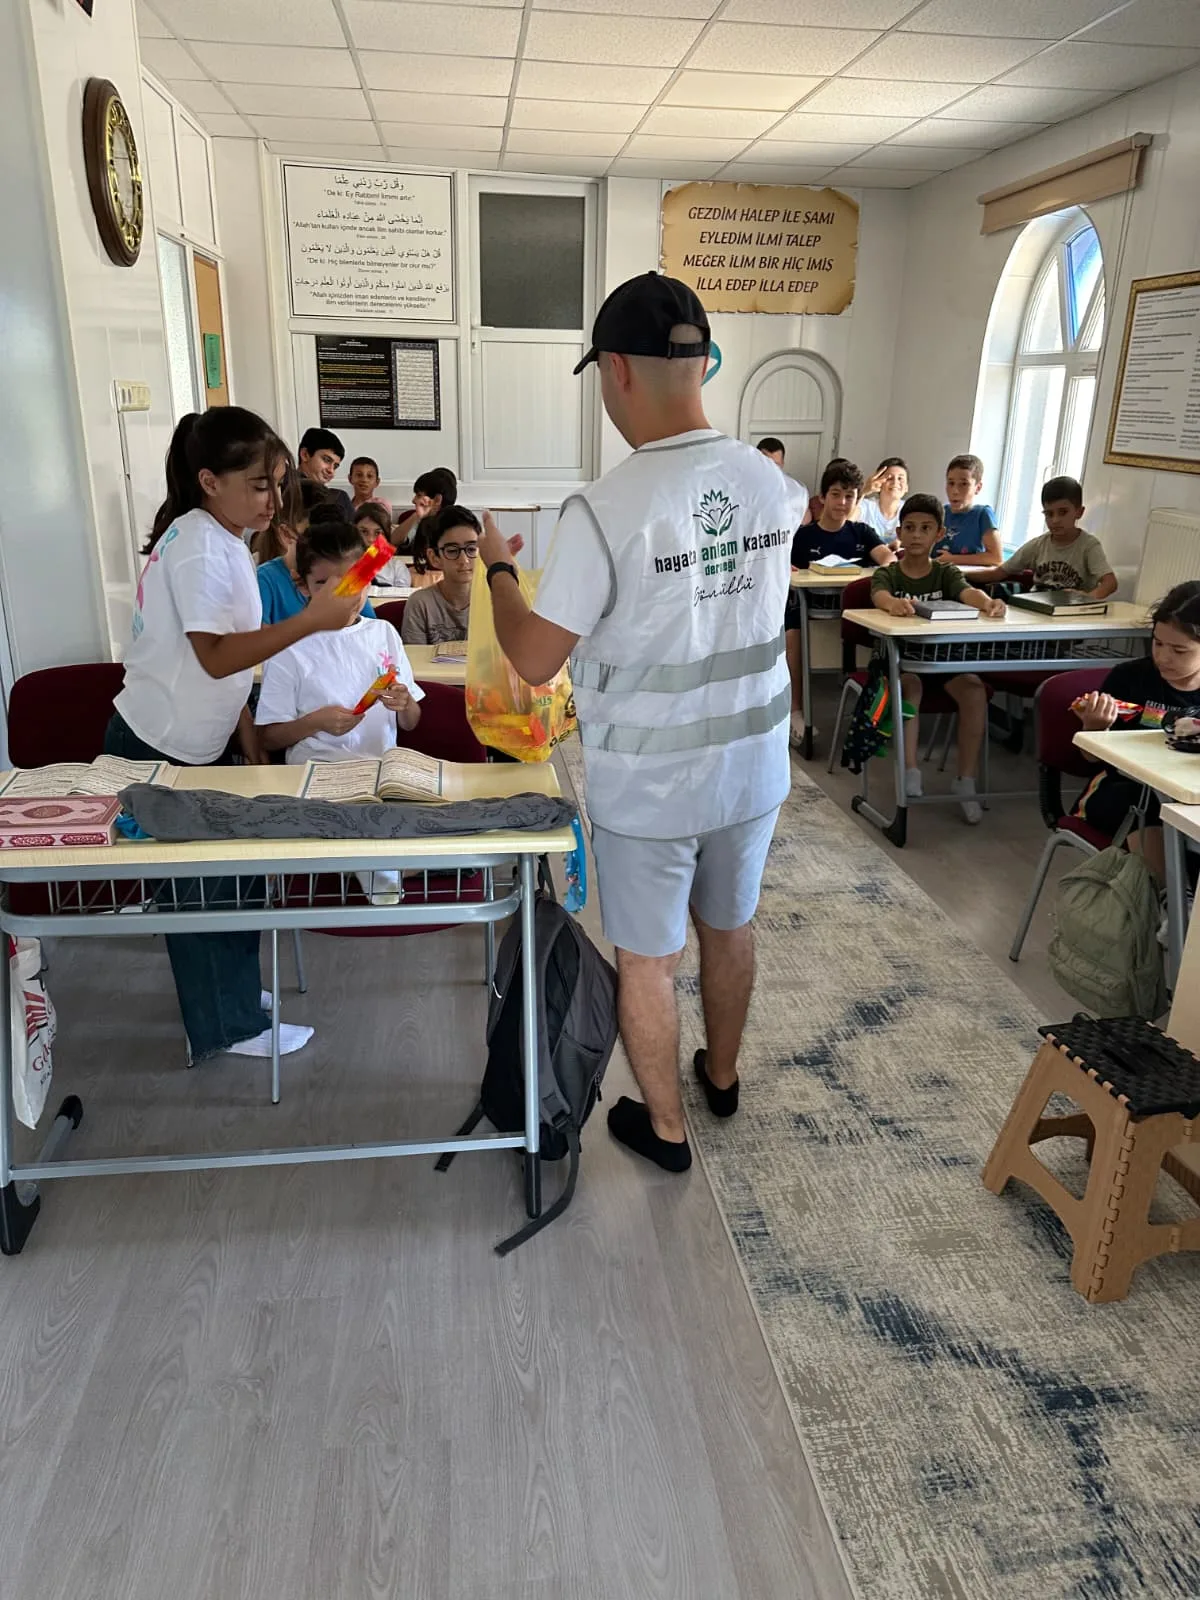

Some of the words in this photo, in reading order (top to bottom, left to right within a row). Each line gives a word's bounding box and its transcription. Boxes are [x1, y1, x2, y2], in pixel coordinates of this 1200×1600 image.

[345, 190, 353, 199] Ey
[688, 206, 737, 221] GEZDİM
[739, 208, 780, 222] HALEP
[782, 208, 801, 223] İLE
[803, 210, 836, 225] ŞAMI
[699, 231, 752, 245] EYLEDİM
[755, 231, 783, 246] İLMİ
[785, 233, 821, 248] TALEP
[728, 254, 757, 269] İLİM
[758, 255, 779, 270] BİR
[782, 256, 805, 272] HİÇ
[725, 278, 757, 292] EDEP
[788, 280, 819, 294] EDEP
[701, 540, 738, 562] anlam
[743, 528, 791, 553] katanlar
